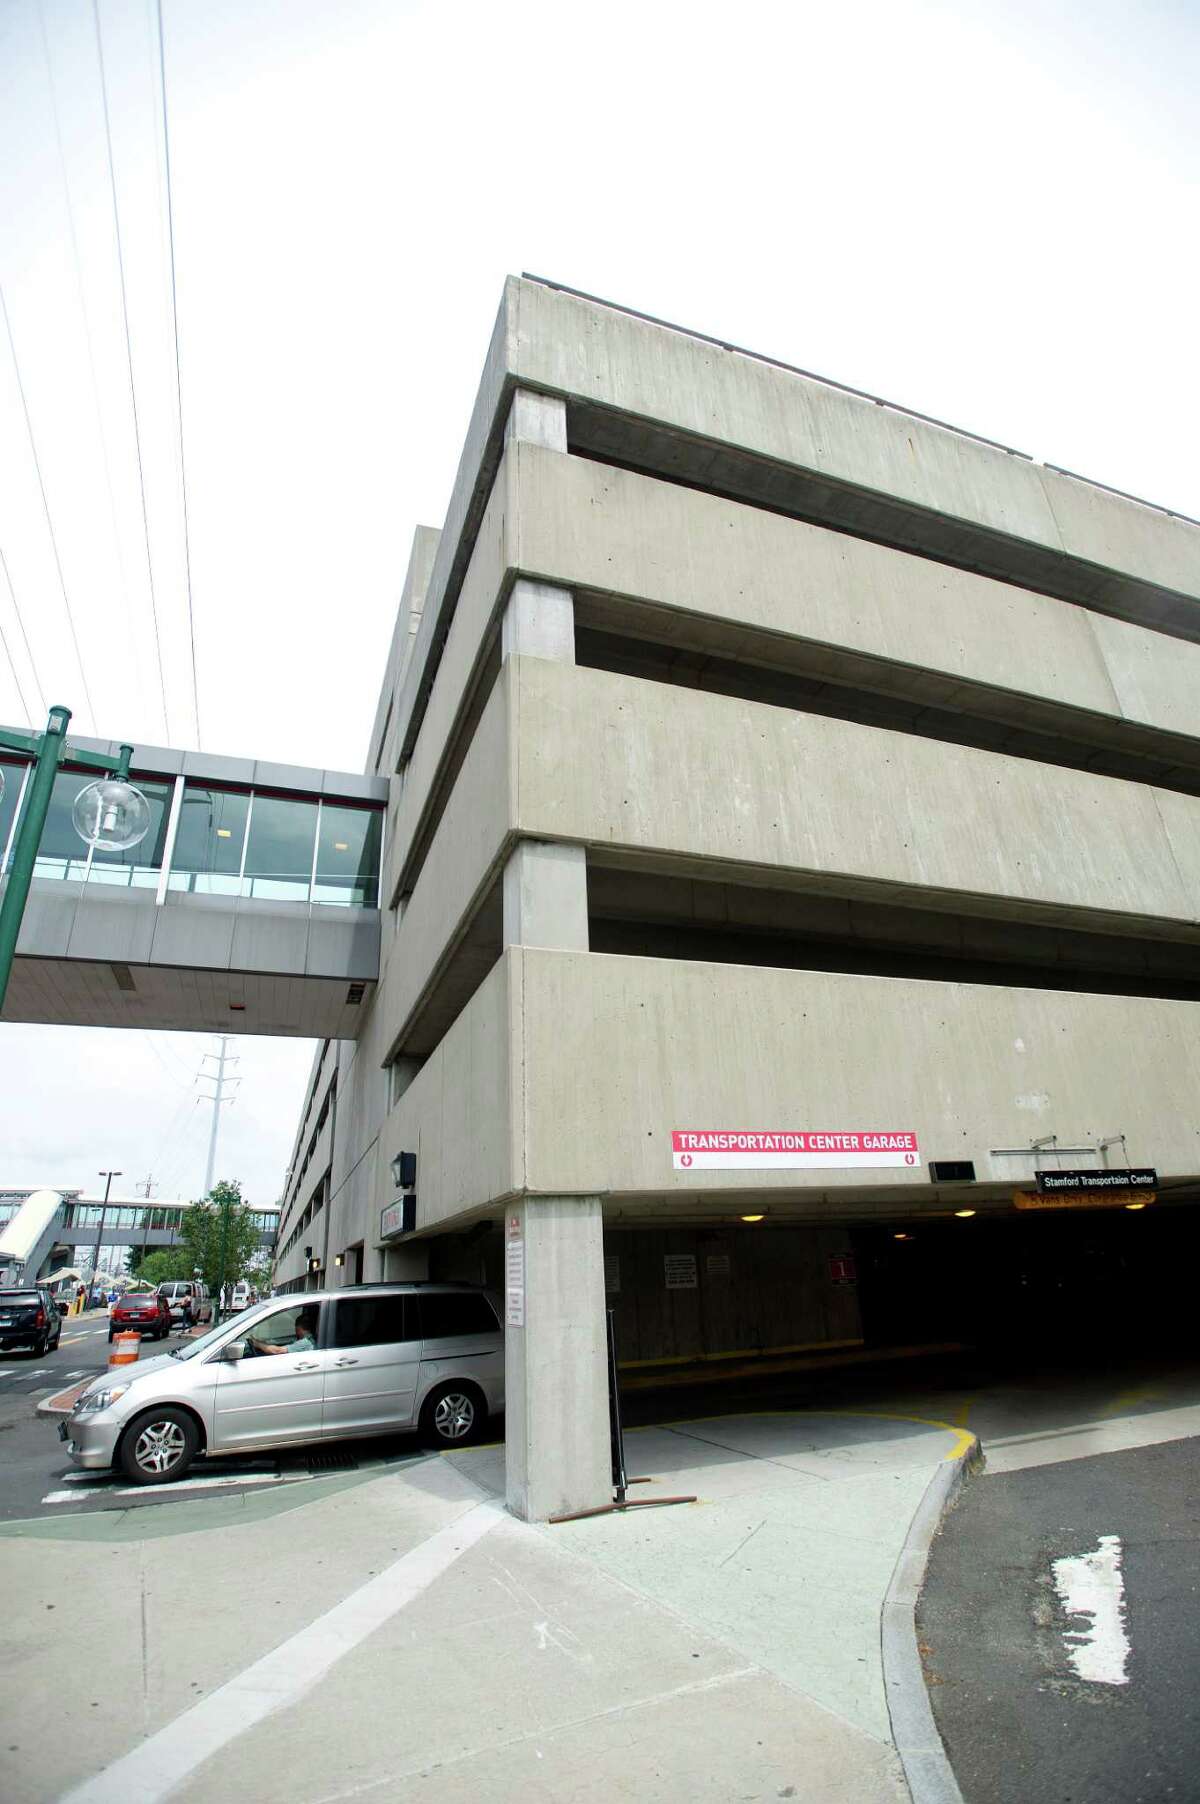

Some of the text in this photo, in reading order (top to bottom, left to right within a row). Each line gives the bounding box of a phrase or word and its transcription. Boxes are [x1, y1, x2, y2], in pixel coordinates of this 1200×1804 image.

[678, 1134, 913, 1149] TRANSPORTATION CENTER GARAGE
[1044, 1177, 1079, 1187] Stamford
[1130, 1174, 1154, 1184] Center
